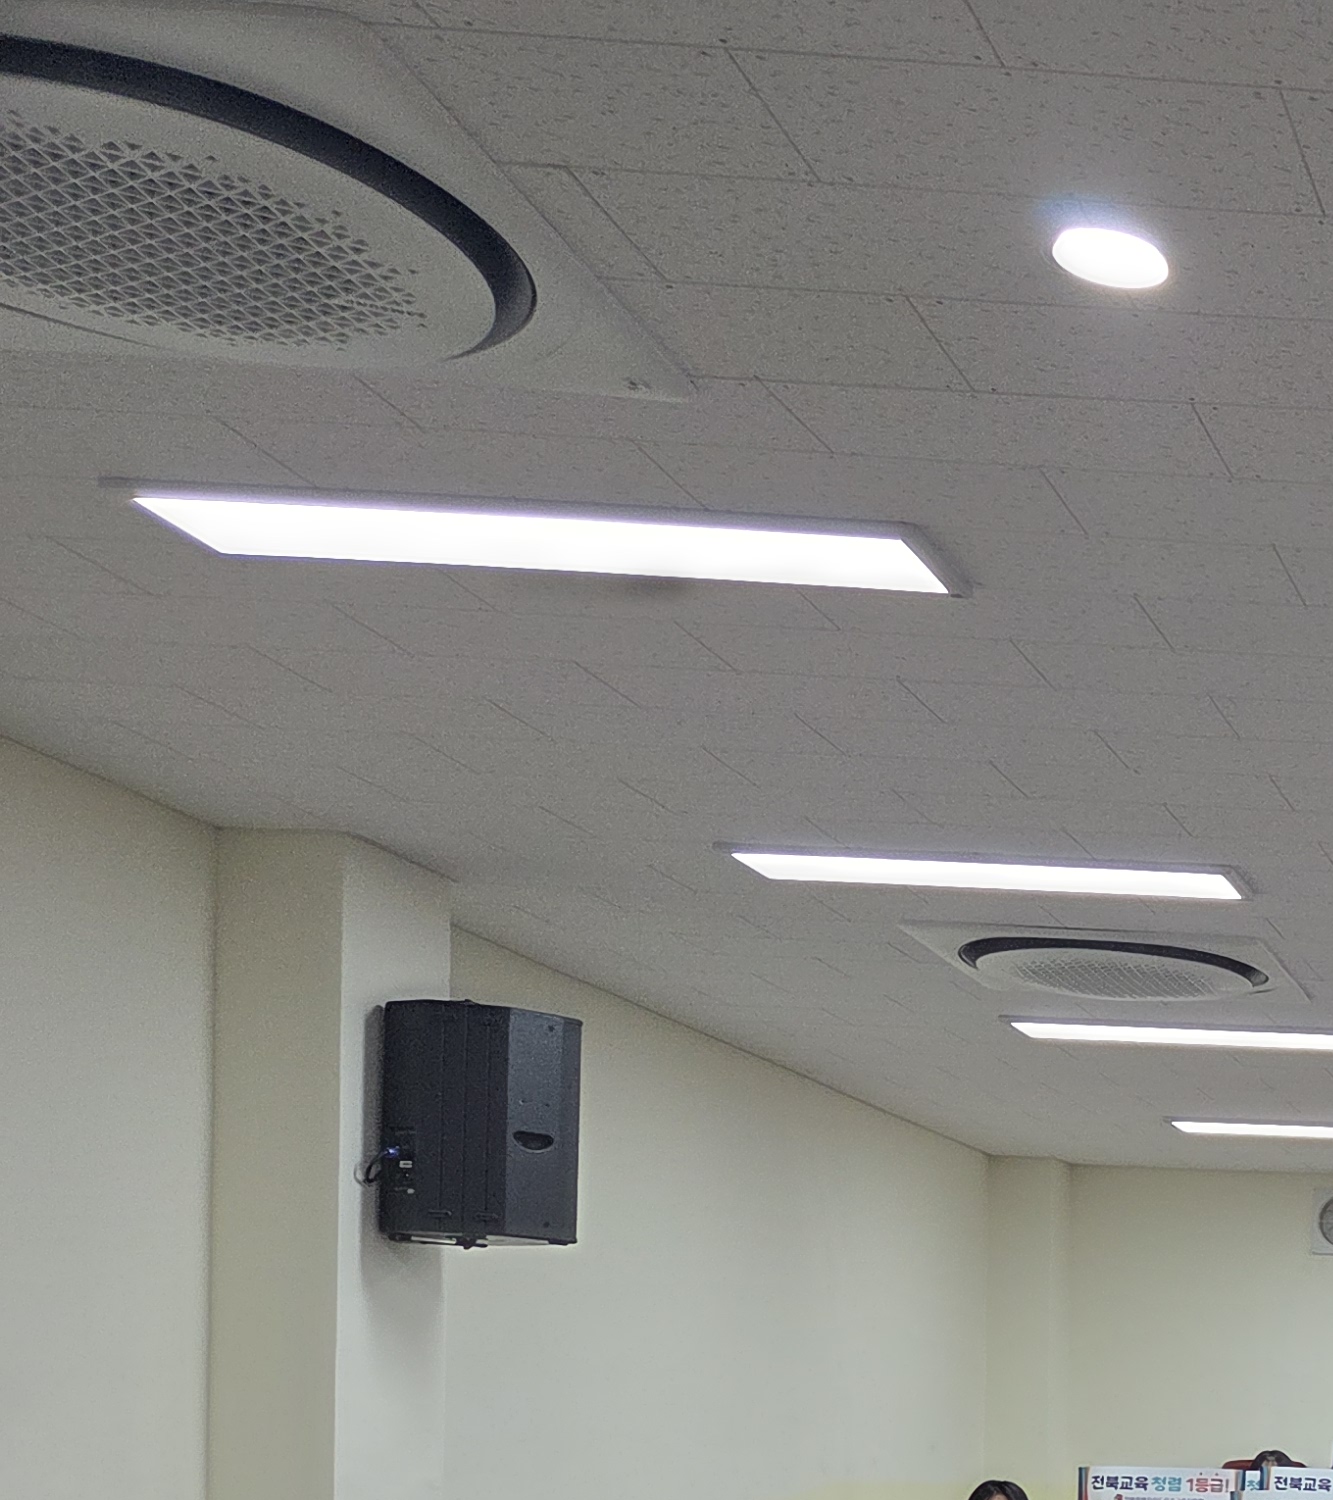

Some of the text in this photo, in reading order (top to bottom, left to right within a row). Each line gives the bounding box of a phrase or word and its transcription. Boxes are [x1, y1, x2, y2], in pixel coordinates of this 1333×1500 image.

[1091, 1472, 1228, 1492] 전북교육 청렴 1등급!
[1274, 1477, 1331, 1492] 전북교육
